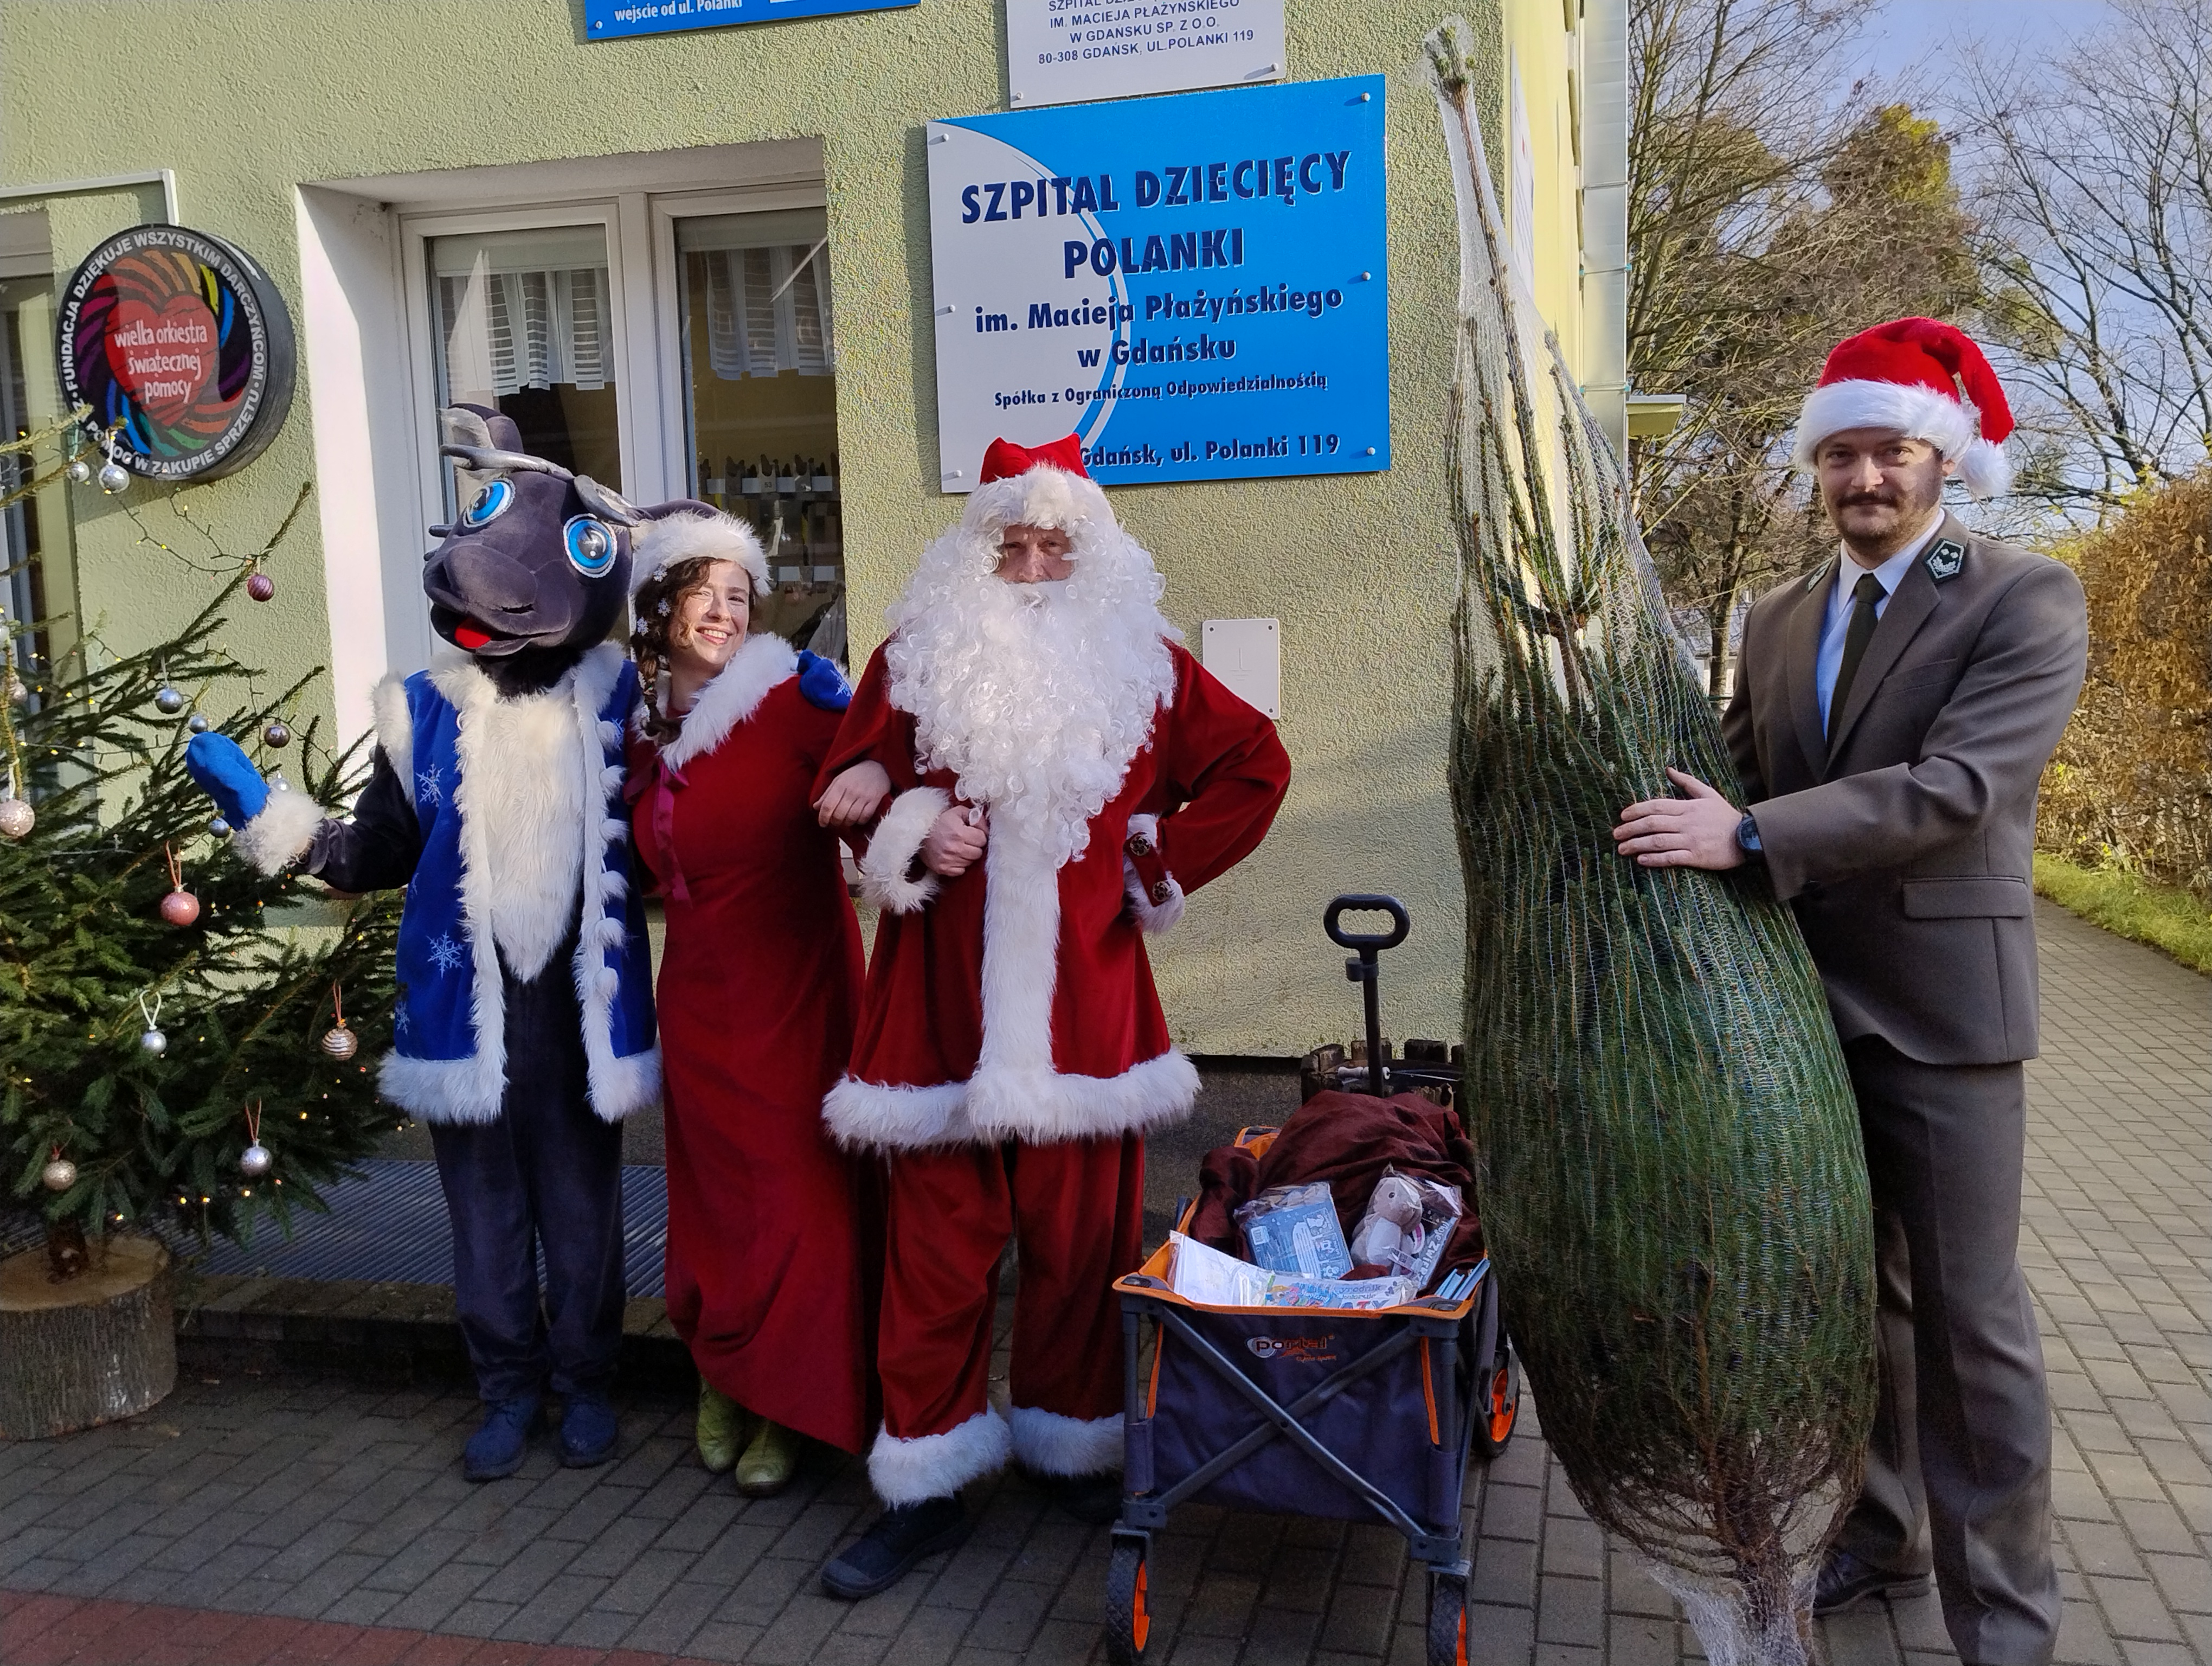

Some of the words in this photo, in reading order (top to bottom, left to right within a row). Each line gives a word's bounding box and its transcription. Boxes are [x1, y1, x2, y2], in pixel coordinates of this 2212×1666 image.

[661, 0, 676, 16] od
[679, 0, 695, 14] ul.
[1050, 17, 1068, 28] IM.
[1072, 9, 1130, 26] MACIEJA
[1038, 50, 1078, 64] 80-308
[1233, 30, 1253, 42] 119
[1070, 31, 1082, 43] W
[1156, 21, 1175, 33] SP.
[1180, 19, 1188, 31] Z
[961, 174, 1120, 224] SZPITAL
[1135, 151, 1351, 208] DZIECIĘCY
[1064, 228, 1244, 279] POLANKI
[61, 300, 81, 392] FUNDACJA
[74, 238, 133, 298] DZIĘKUJE
[132, 231, 222, 267] WSZYSTKIM
[220, 264, 265, 381] DARCZYŃCOM
[975, 306, 1018, 332] im.
[1028, 296, 1135, 331] Macieja
[1146, 283, 1343, 323] Płażyńskiego
[114, 320, 154, 348] wielka
[156, 317, 208, 344] orkiestra
[127, 348, 202, 381] świątecznej
[1077, 349, 1101, 368] w
[1111, 333, 1236, 366] Gdańsku
[144, 379, 192, 405] pomocy
[994, 387, 1046, 410] Spółka
[1052, 393, 1059, 403] z
[1065, 383, 1162, 406] Ograniczoną
[1167, 370, 1327, 399] Odpowiedzialnością
[135, 456, 148, 471] W
[152, 450, 215, 475] ZAKUPIE
[215, 388, 260, 456] SPRZĘTU
[1081, 443, 1163, 467] Gdańsk,
[1171, 441, 1198, 463] ul.
[1206, 435, 1289, 460] Polanki
[1298, 434, 1340, 455] 119
